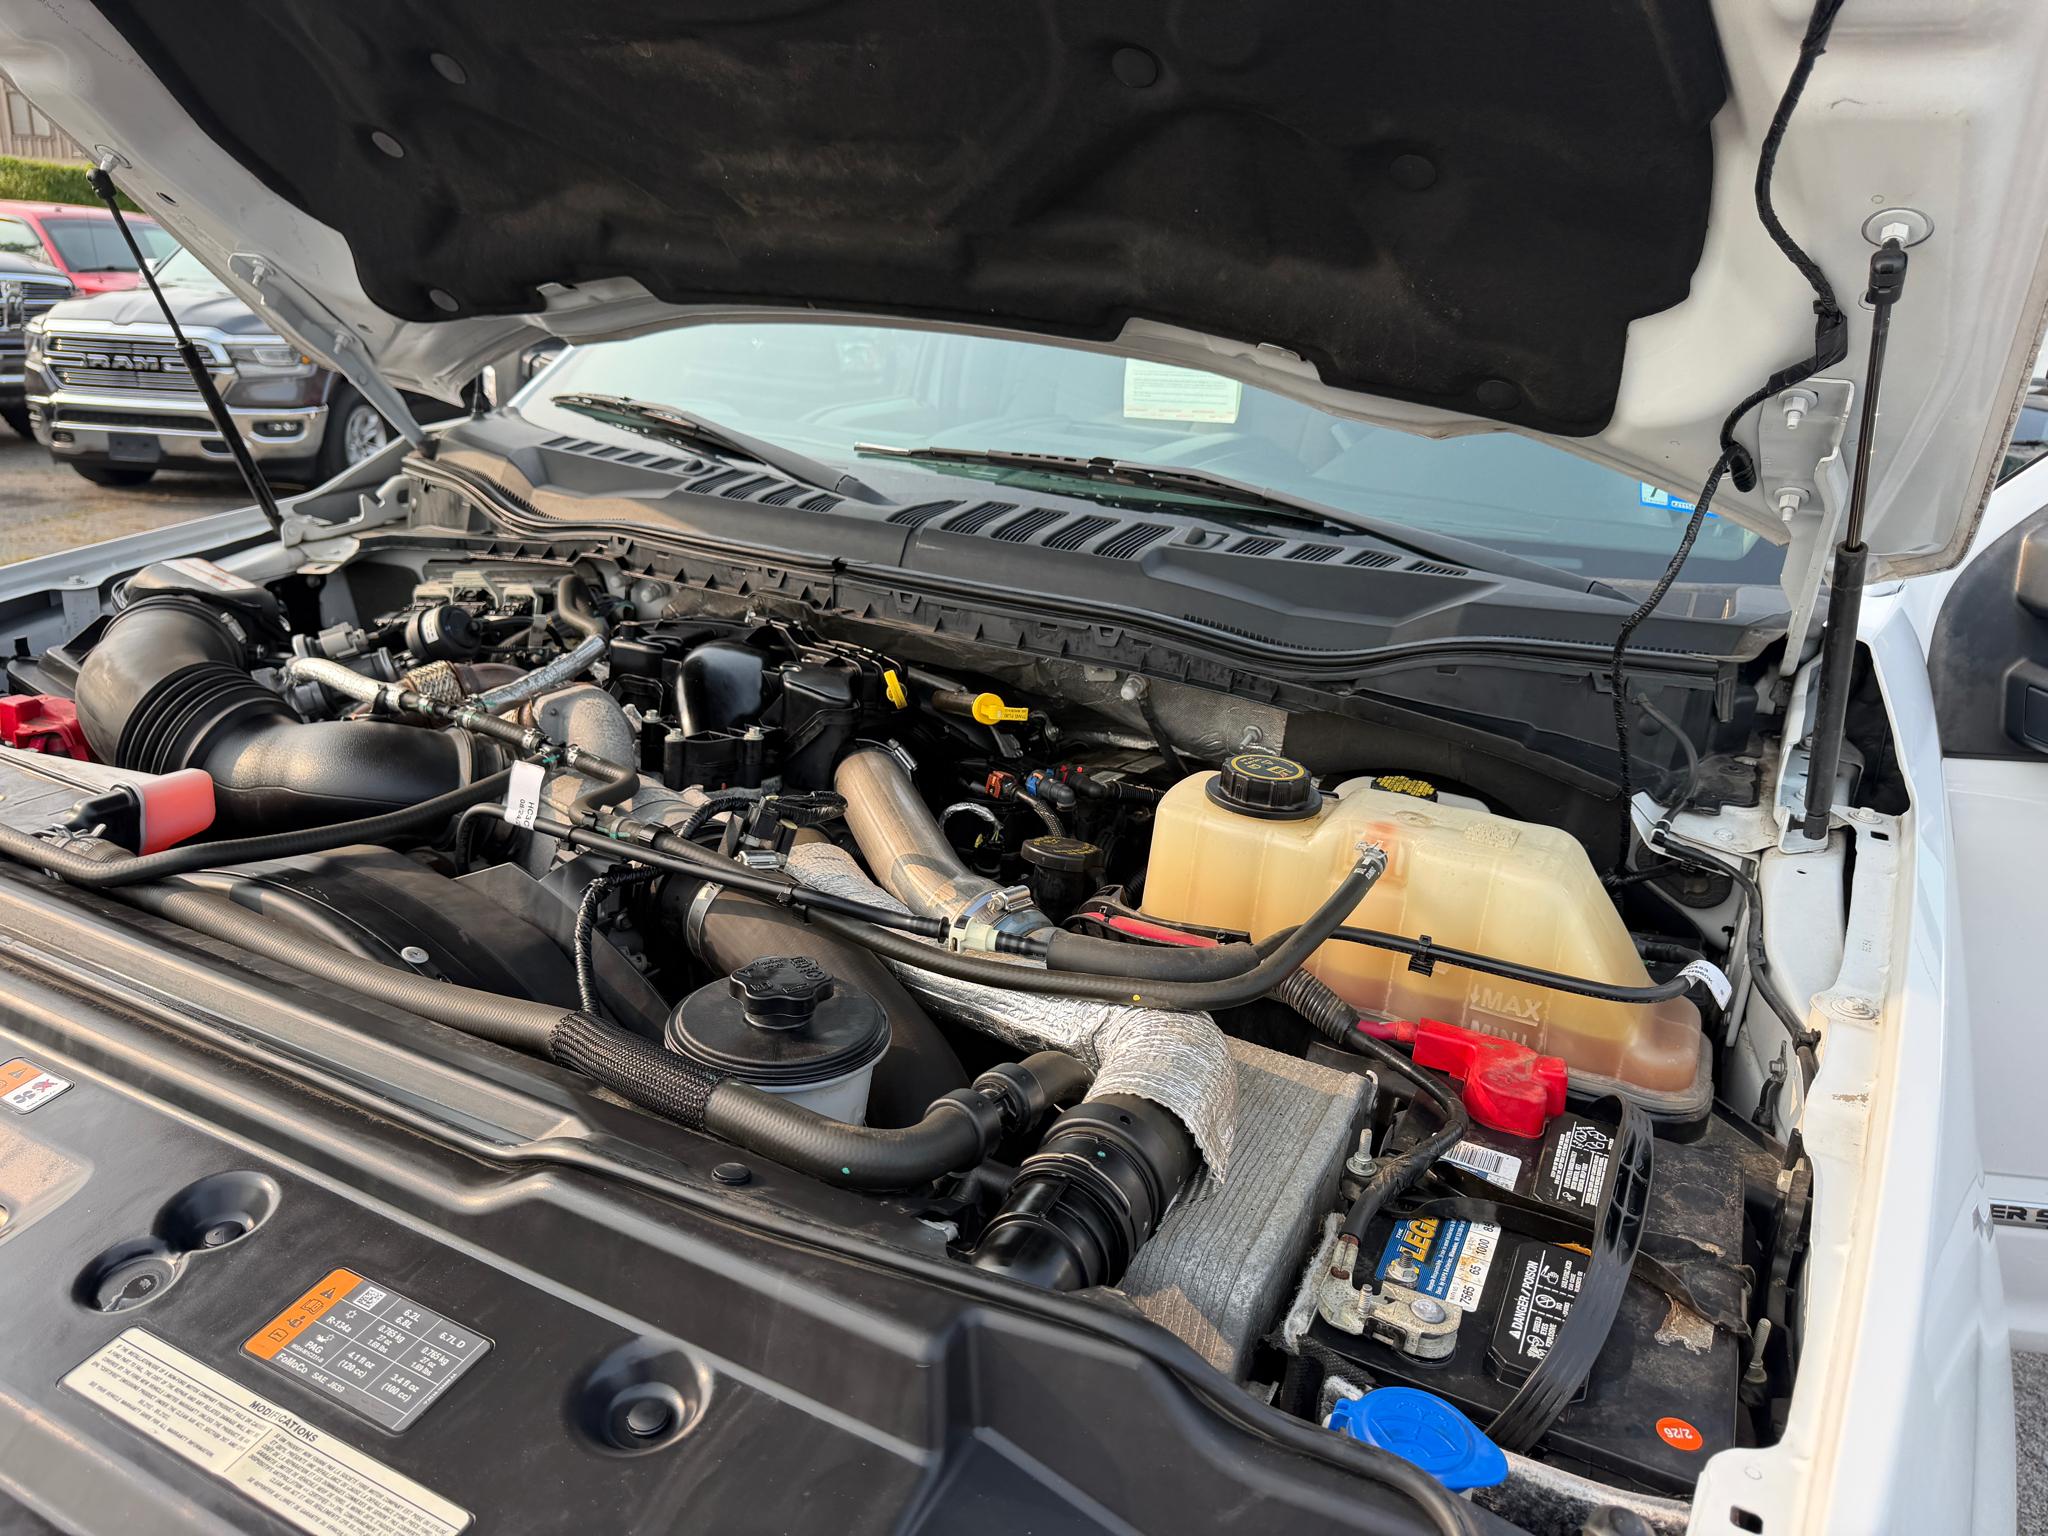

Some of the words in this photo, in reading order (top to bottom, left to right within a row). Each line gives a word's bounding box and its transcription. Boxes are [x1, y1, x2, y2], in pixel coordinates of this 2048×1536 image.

[86, 353, 159, 371] RAM
[1481, 987, 1542, 1022] MAX
[1476, 1239, 1490, 1256] 1000
[1470, 1265, 1481, 1276] 65
[1511, 1298, 1530, 1330] DANGER
[1524, 1260, 1539, 1289] POISON
[395, 1316, 413, 1329] 6.8L
[403, 1309, 420, 1322] 6.2L
[326, 1316, 352, 1333] R-134a
[1540, 1323, 1548, 1335] EYES
[378, 1325, 398, 1337] 0.765
[395, 1333, 405, 1343] kg
[439, 1332, 457, 1345] 6.7L
[456, 1340, 466, 1348] D
[304, 1340, 324, 1354] PAG
[347, 1352, 360, 1361] 4.1
[364, 1361, 375, 1369] oz
[421, 1347, 441, 1360] 0.765
[439, 1356, 450, 1366] kg
[276, 1352, 308, 1374] FoMoCo
[311, 1372, 328, 1384] SAE
[327, 1381, 345, 1392] J639
[337, 1359, 356, 1371] (120
[354, 1368, 367, 1379] cc)
[390, 1374, 405, 1383] 3.4
[409, 1384, 419, 1392] oz
[381, 1382, 400, 1395] (100
[398, 1391, 412, 1403] cc)
[249, 1400, 319, 1442] MODIFICATIONS
[1664, 1427, 1693, 1439] 2/26
